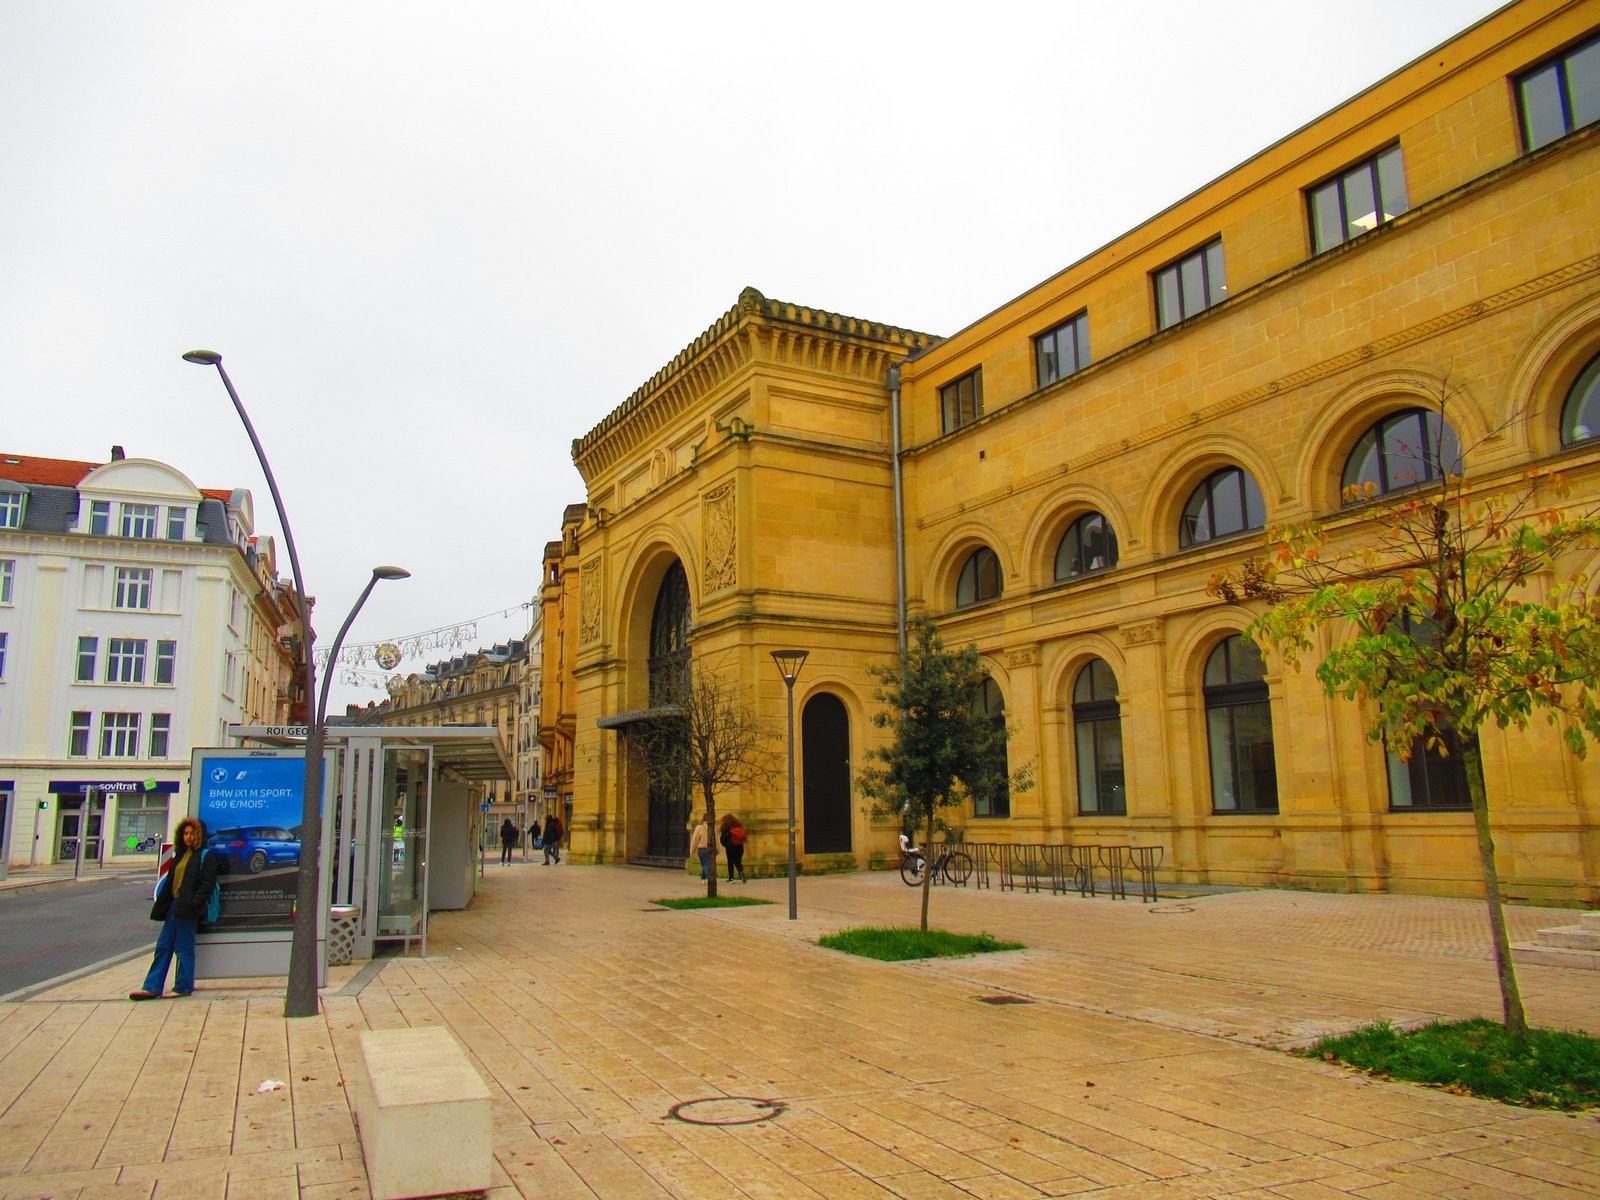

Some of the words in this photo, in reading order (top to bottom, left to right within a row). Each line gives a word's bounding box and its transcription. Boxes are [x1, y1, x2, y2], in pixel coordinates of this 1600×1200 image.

[266, 727, 284, 736] ROI
[287, 727, 329, 736] GEOE
[99, 782, 137, 791] sovitrat
[209, 789, 234, 798] BMW
[234, 789, 248, 798] iX1
[249, 789, 258, 798] M
[260, 789, 293, 798] SPORT.
[209, 801, 228, 809] 490
